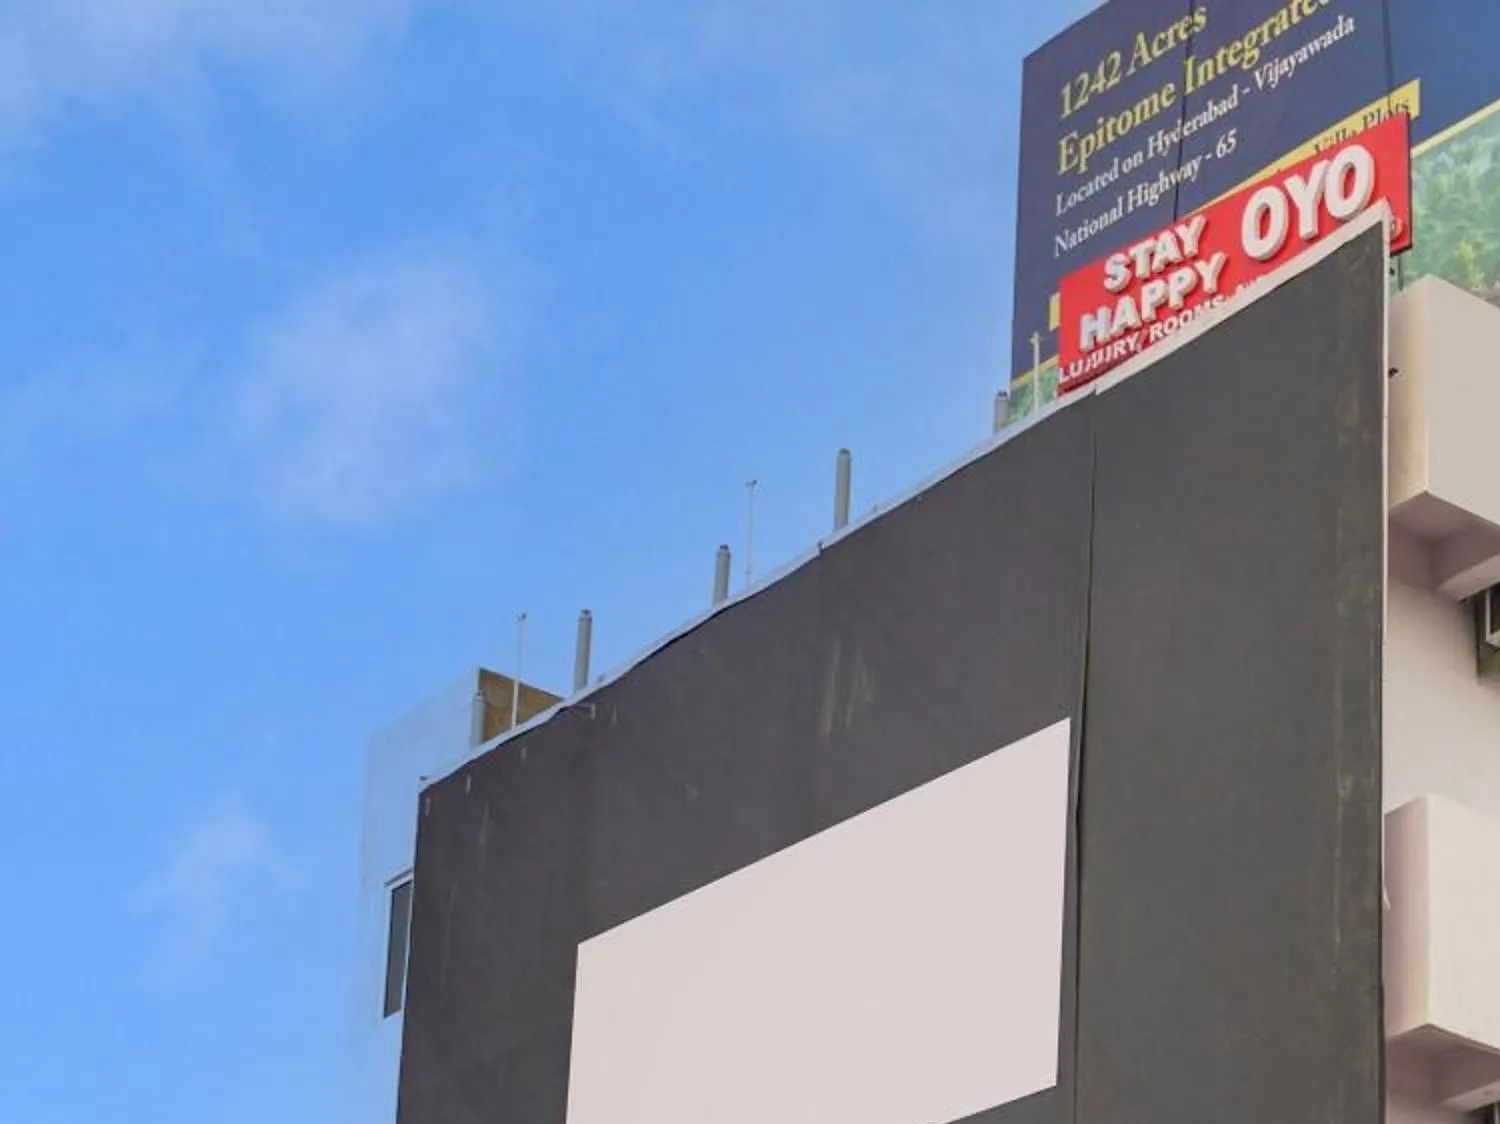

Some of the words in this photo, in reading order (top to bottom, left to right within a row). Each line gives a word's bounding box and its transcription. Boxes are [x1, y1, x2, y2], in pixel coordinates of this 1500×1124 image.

[1056, 157, 1119, 216] Located
[1122, 150, 1144, 174] on
[1147, 83, 1239, 157] Hyderabad
[1254, 14, 1355, 91] Vijayawada
[1061, 51, 1122, 119] 1242
[1126, 7, 1207, 77] Acres
[1058, 83, 1176, 174] Epitome
[1054, 195, 1124, 259] National
[1127, 153, 1203, 207] Highway
[1216, 128, 1238, 160] 65
[1242, 144, 1375, 262] OYO
[1079, 251, 1226, 352] HAPPY
[1103, 215, 1205, 292] STAY
